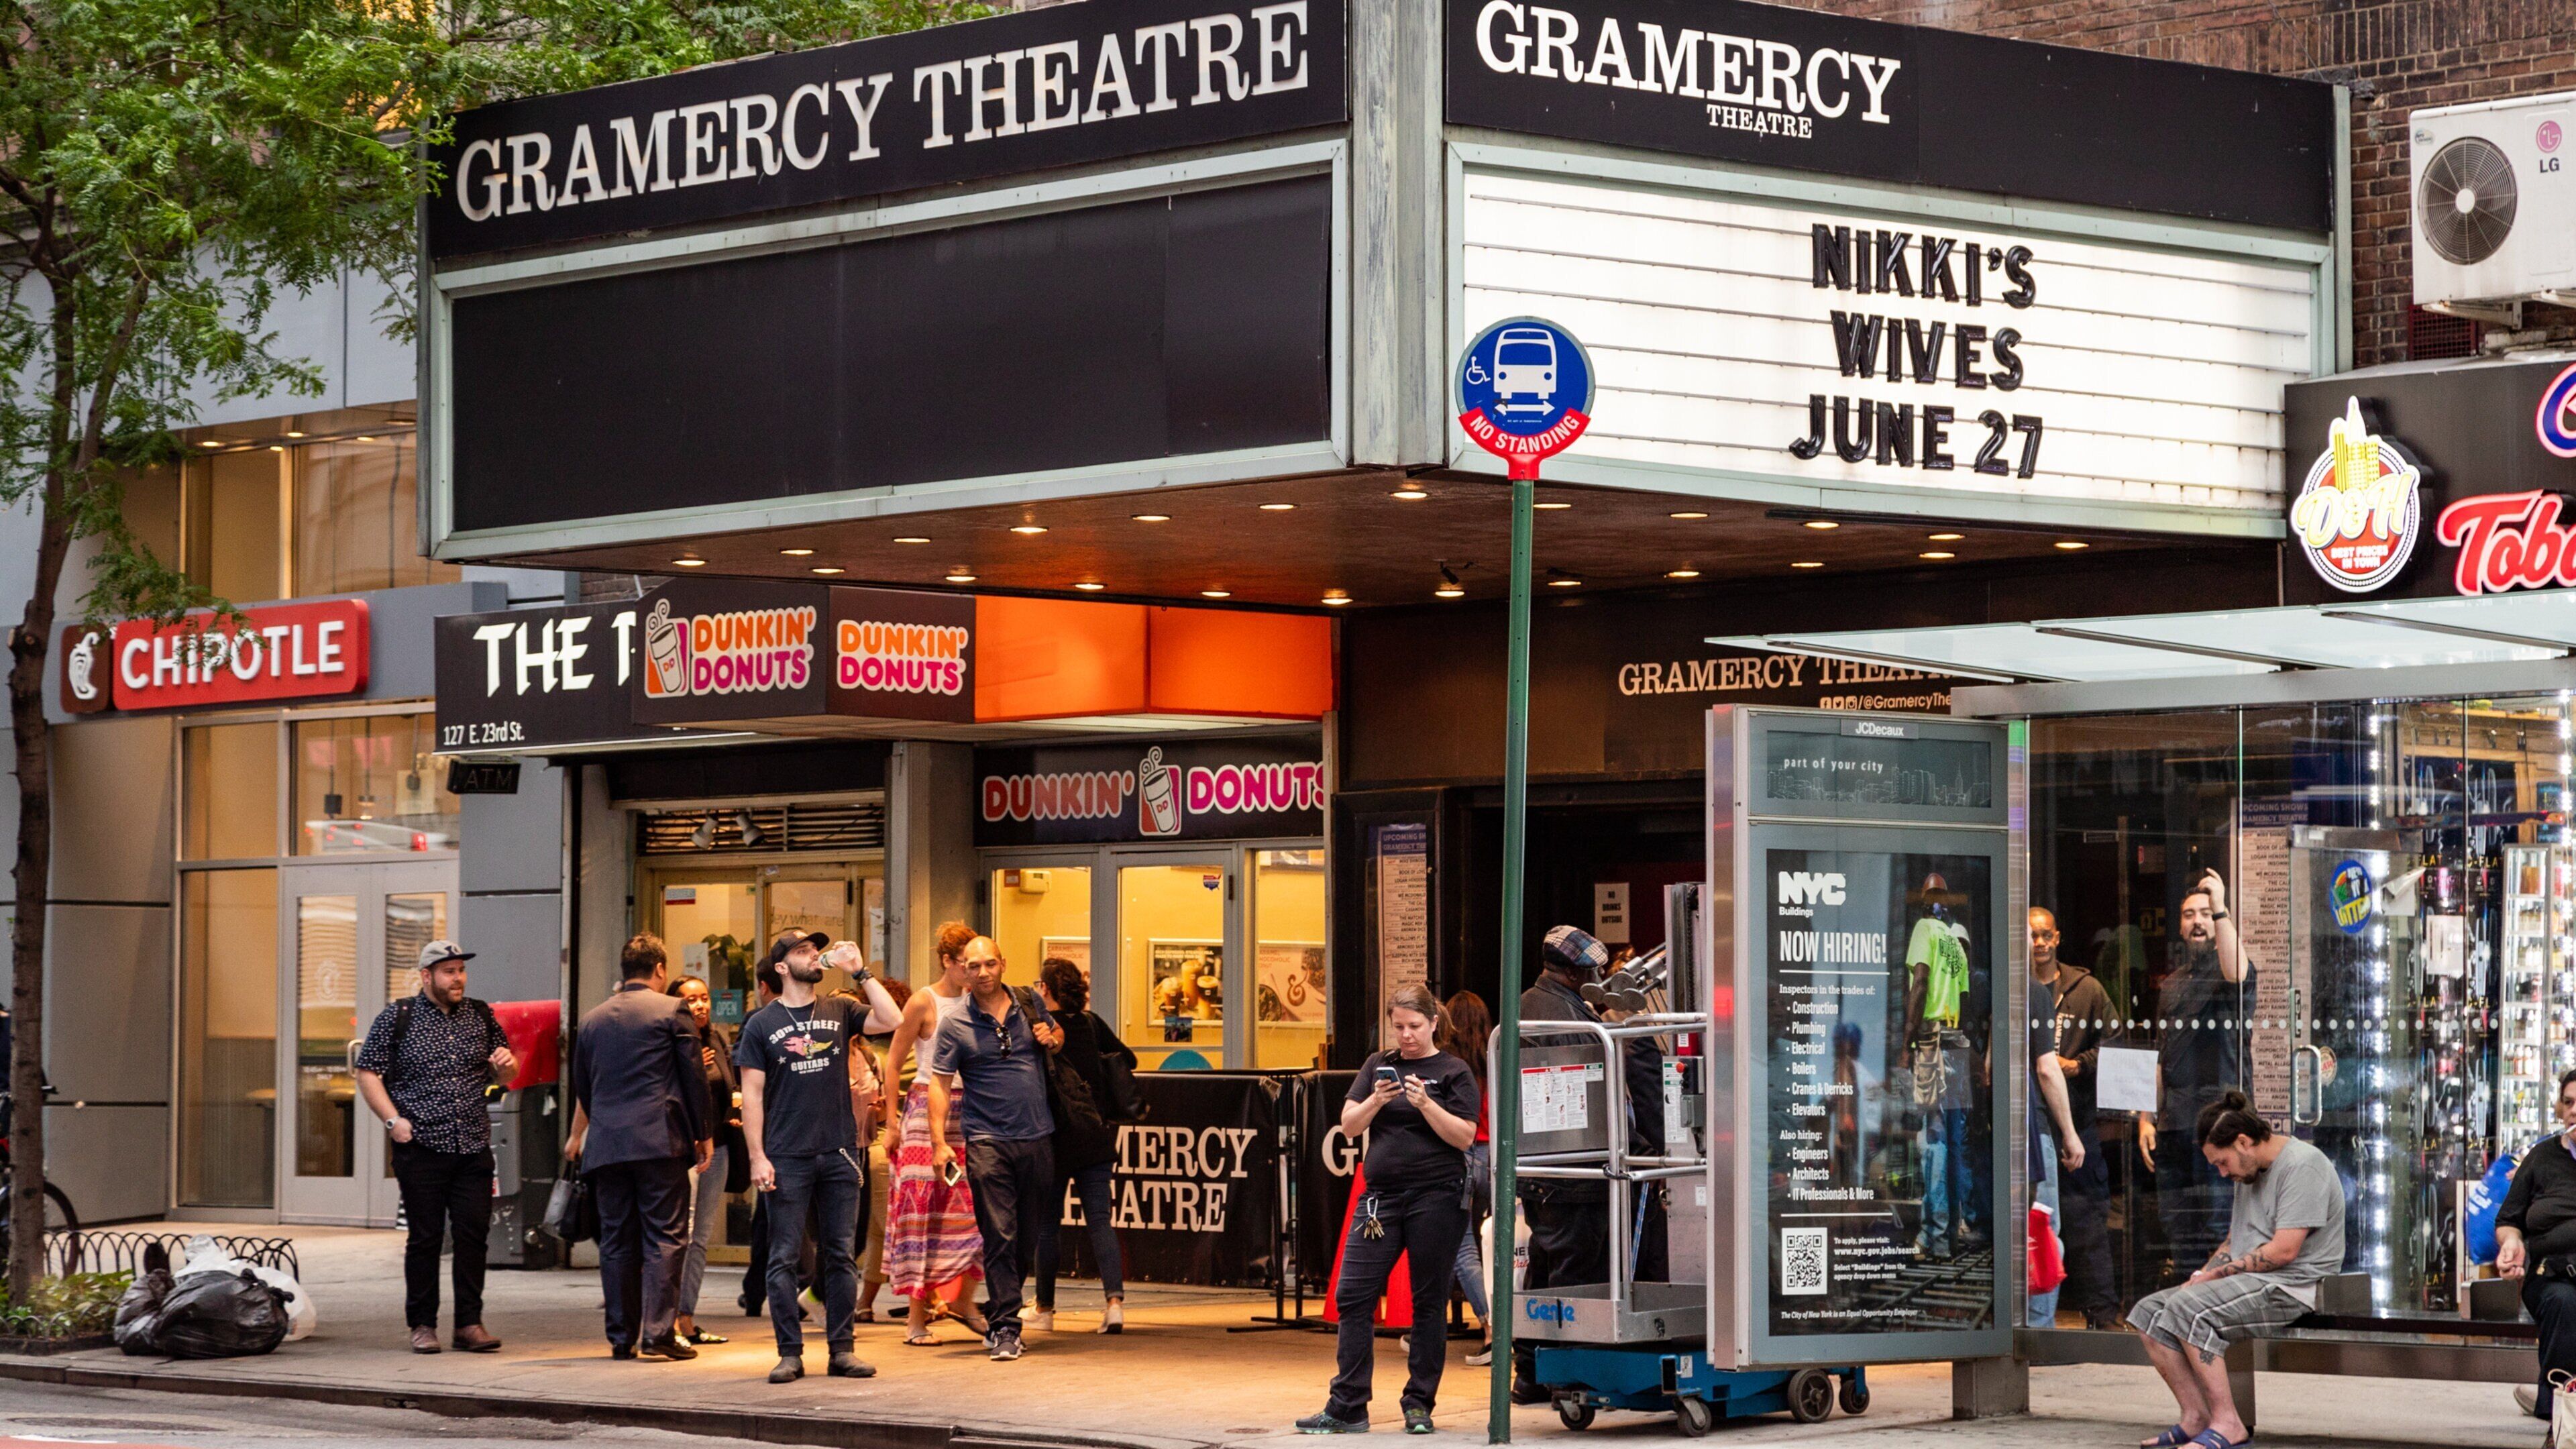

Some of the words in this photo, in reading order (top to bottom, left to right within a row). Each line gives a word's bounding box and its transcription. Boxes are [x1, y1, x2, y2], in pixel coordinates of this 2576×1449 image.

[1477, 0, 1900, 124] GRAMERCY
[457, 72, 893, 222] GRAMERCY
[914, 0, 1307, 149] THEATRE
[1707, 103, 1812, 138] THEATRE
[2540, 158, 2560, 173] LG
[1813, 223, 2037, 309] NIKKI'S
[1830, 310, 2023, 392] WIVES
[1470, 415, 1494, 435] NO
[1495, 415, 1580, 453] STANDING
[1789, 394, 1954, 470] JUNE
[1974, 409, 2043, 479] 27
[693, 610, 814, 653] DUNKIN'
[841, 623, 965, 659] DUNKIN'
[121, 621, 345, 689] CHIPOTLE
[473, 616, 594, 697] THE
[693, 648, 806, 690] DONUTS
[840, 656, 959, 691] DONUTS
[1619, 655, 1807, 696] GRAMERCY
[1816, 657, 1953, 685] THEA
[444, 725, 464, 745] 127
[470, 724, 480, 743] E.
[482, 721, 507, 743] 23rd
[510, 722, 525, 741] St.
[1856, 722, 1904, 736] JCDecaux
[1784, 758, 1807, 769] part
[1813, 757, 1825, 769] of
[1831, 761, 1856, 771] your
[1861, 759, 1884, 773] city
[464, 769, 512, 791] ATM
[985, 773, 1133, 819] DUNKIN'
[1778, 871, 1846, 905] NYC
[1779, 906, 1814, 918] Buildings
[1780, 930, 1819, 962] NOW
[1823, 932, 1887, 963] HIRING!
[1779, 984, 1818, 996] Inspectors
[1819, 985, 1827, 994] in
[1829, 985, 1840, 994] the
[1841, 985, 1864, 995] trades
[1866, 985, 1876, 995] of:
[1792, 1001, 1838, 1014] Construction
[796, 1019, 841, 1032] STREET
[1792, 1022, 1826, 1037] Plumbing
[1792, 1042, 1825, 1055] Electrical
[790, 1057, 830, 1072] GUITARS
[1792, 1062, 1817, 1075] Boilers
[1792, 1082, 1817, 1095] Cranes
[1817, 1082, 1823, 1095] &
[1825, 1082, 1854, 1095] Derricks
[1792, 1103, 1826, 1116] Elevators
[1780, 1130, 1796, 1140] Also
[1797, 1130, 1823, 1141] hiring:
[1792, 1147, 1829, 1163] Engineers
[1792, 1167, 1829, 1180] Architects
[1792, 1188, 1800, 1201] IT
[1801, 1187, 1848, 1200] Professionals
[1849, 1187, 1855, 1199] &
[1856, 1187, 1874, 1199] More
[1858, 1236, 1876, 1244] please
[1833, 1273, 1852, 1281] agency
[1854, 1273, 1866, 1281] drop
[1781, 1311, 1790, 1319] The
[1791, 1311, 1801, 1320] City
[1803, 1311, 1809, 1320] of
[1821, 1310, 1832, 1318] York
[1833, 1309, 1838, 1318] is
[1846, 1309, 1862, 1318] Equal
[1862, 1309, 1893, 1318] Opportunity
[1894, 1308, 1918, 1318] Employer
